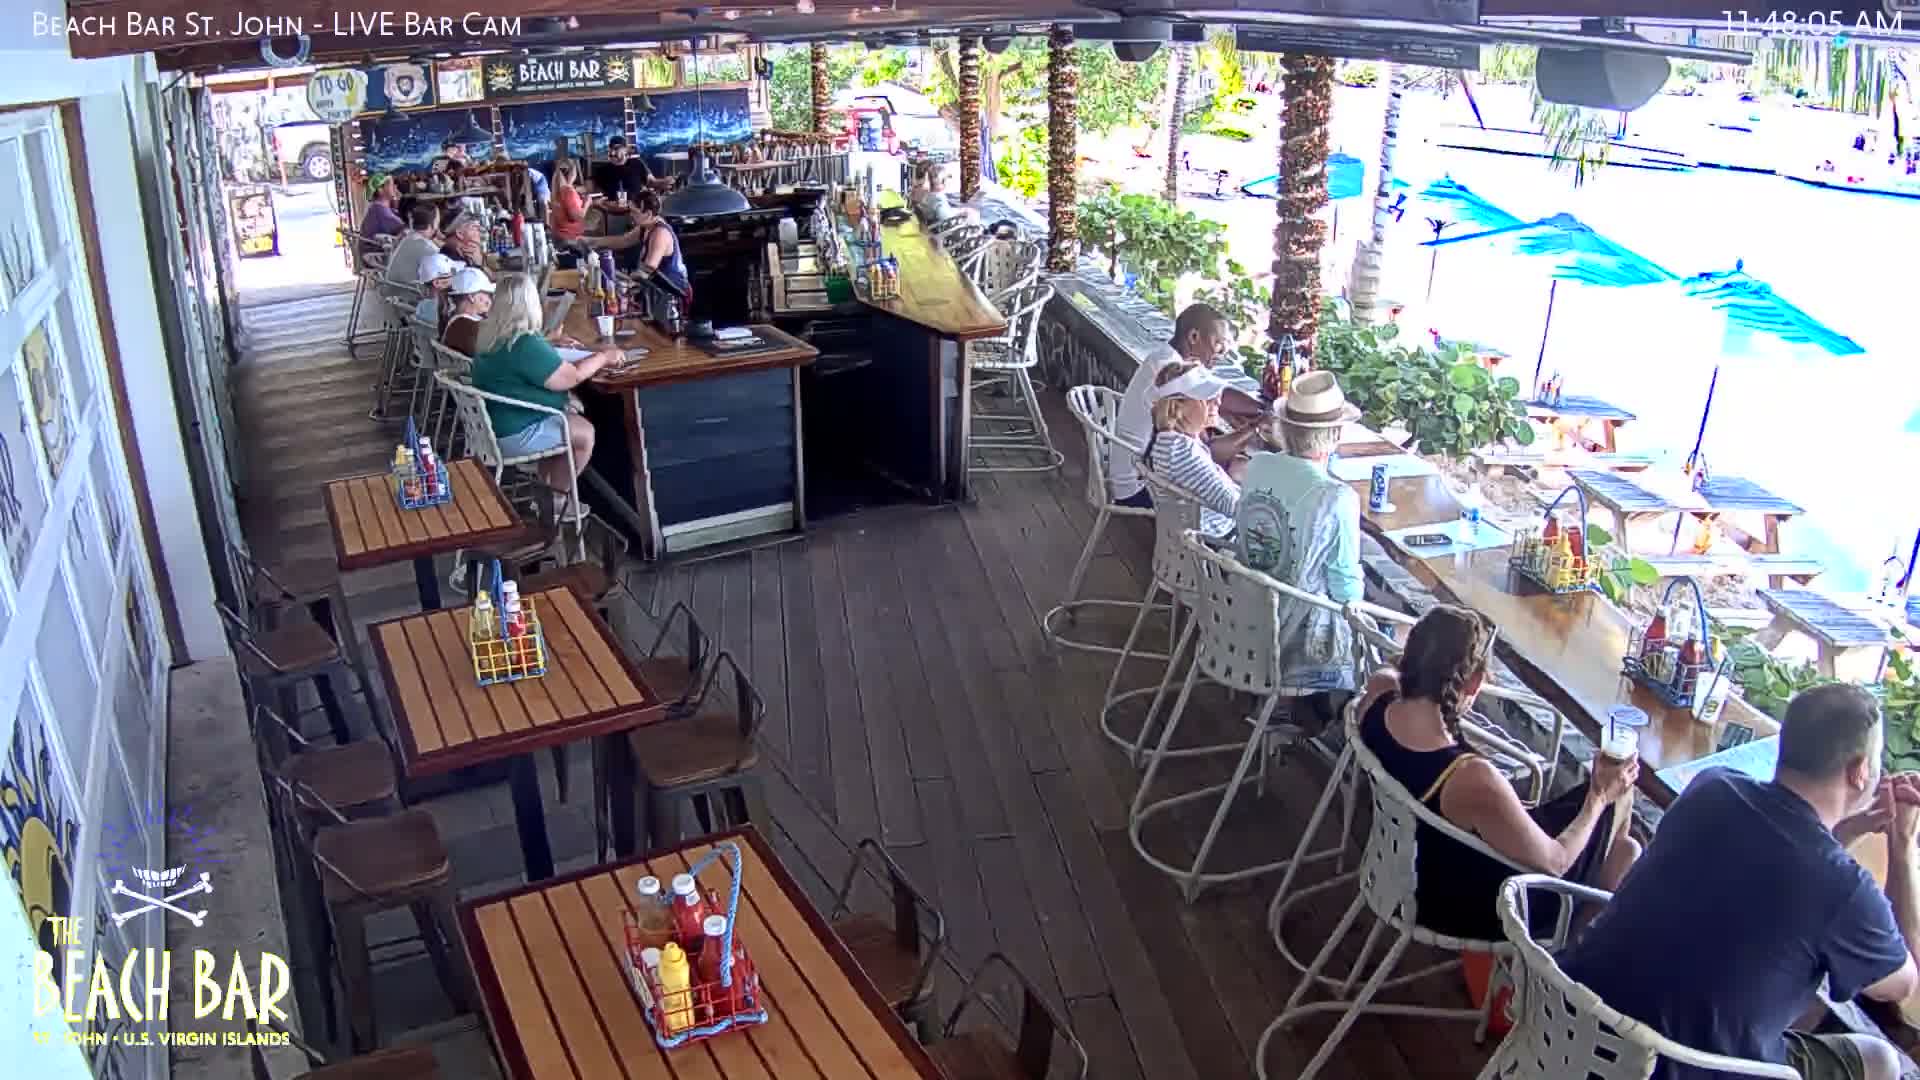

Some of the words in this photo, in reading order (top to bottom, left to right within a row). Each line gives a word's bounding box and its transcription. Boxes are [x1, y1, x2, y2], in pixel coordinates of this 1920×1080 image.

[519, 61, 563, 82] BEACH
[569, 60, 600, 79] BAR
[315, 75, 333, 96] TO
[336, 71, 354, 91] GO
